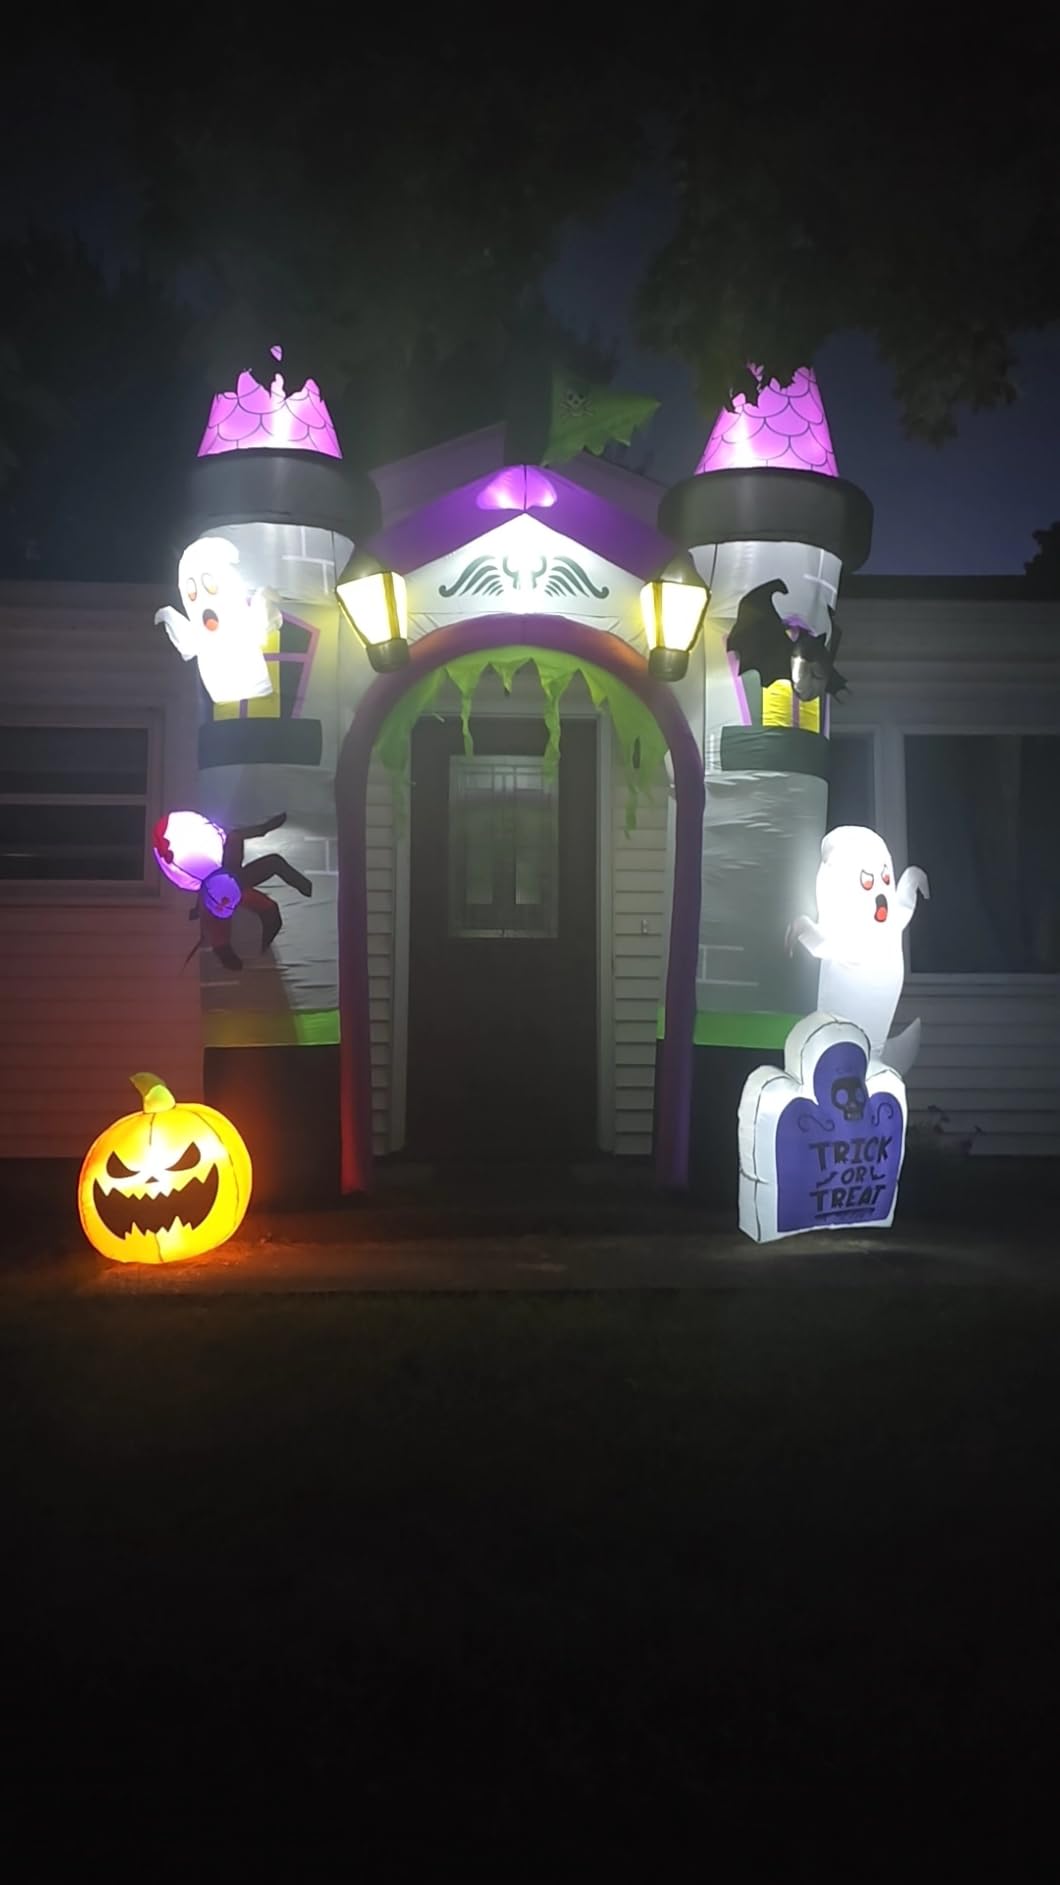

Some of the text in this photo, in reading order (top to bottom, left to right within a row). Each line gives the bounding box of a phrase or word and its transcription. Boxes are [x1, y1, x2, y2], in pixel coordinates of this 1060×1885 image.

[808, 1135, 893, 1172] TRICK
[841, 1165, 868, 1184] OR
[809, 1184, 886, 1212] TREAT
